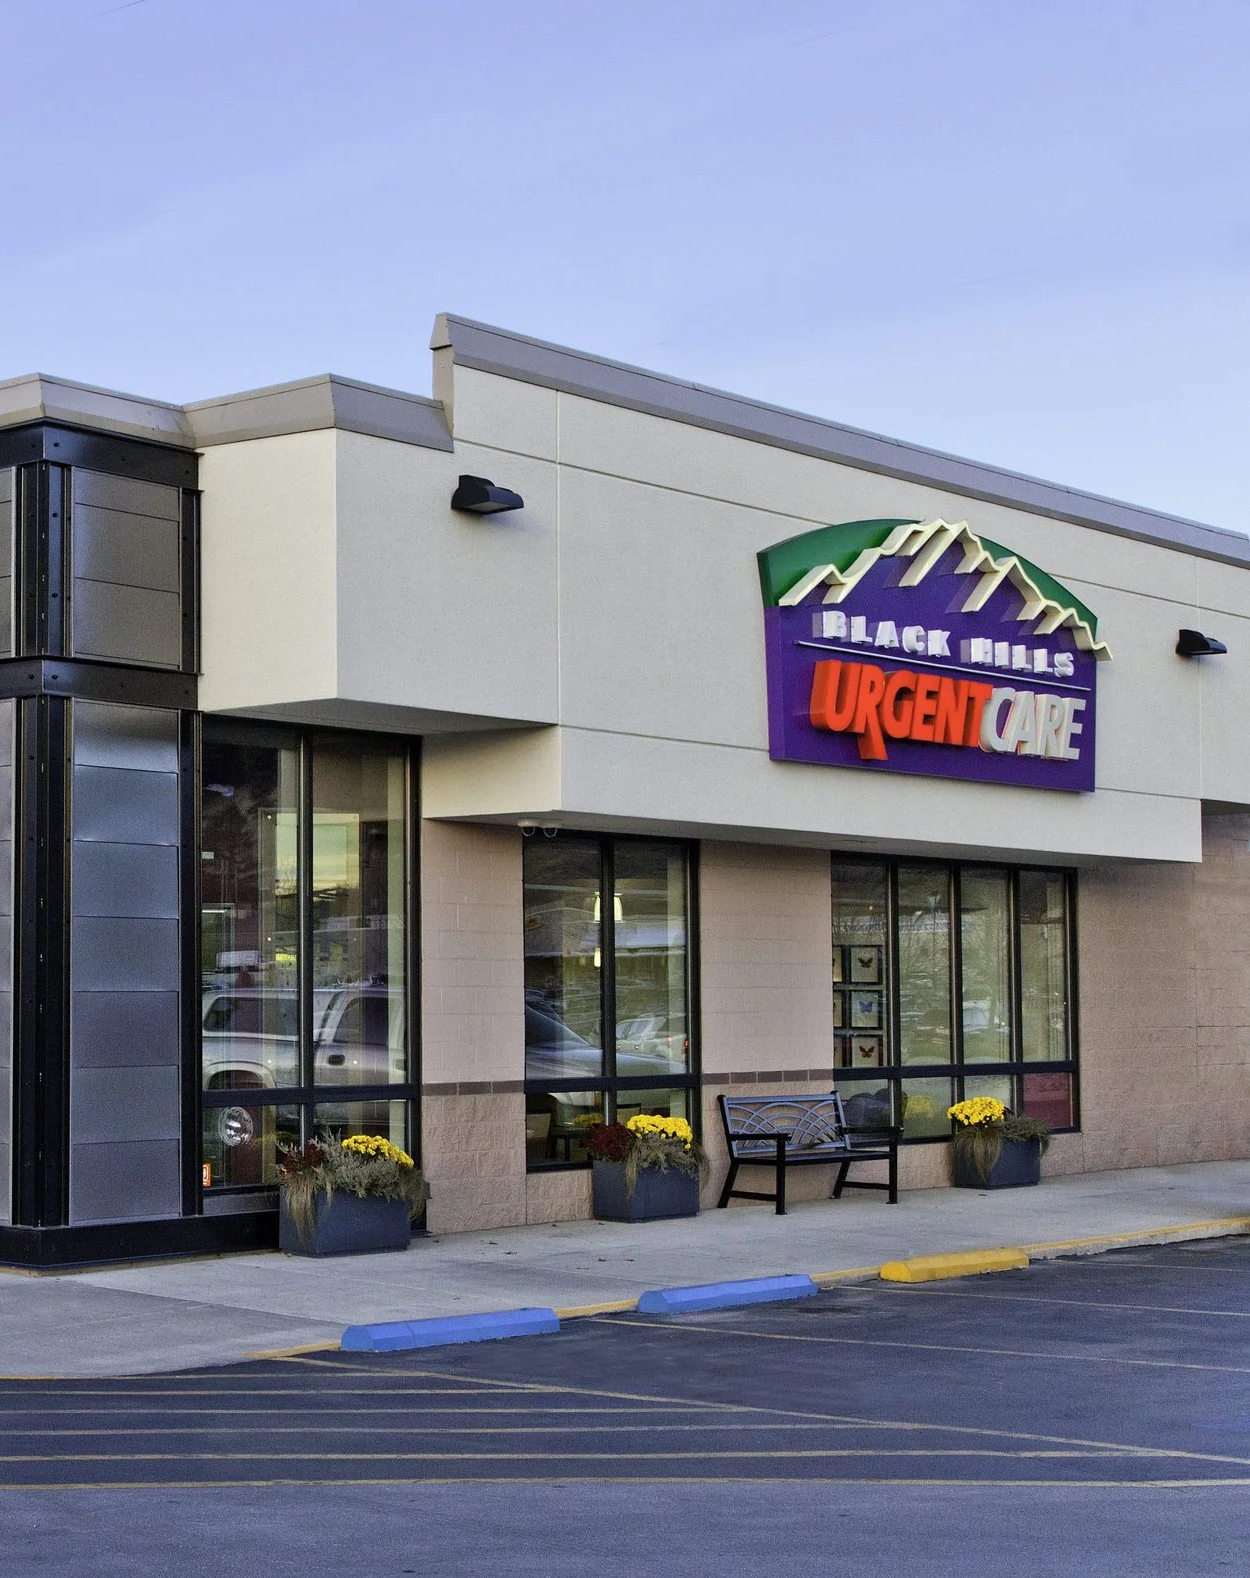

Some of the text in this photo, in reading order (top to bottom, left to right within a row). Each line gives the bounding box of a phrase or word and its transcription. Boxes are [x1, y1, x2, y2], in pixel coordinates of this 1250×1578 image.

[820, 610, 1074, 678] BLACK HILLS
[809, 659, 1086, 761] URGENT CARE
